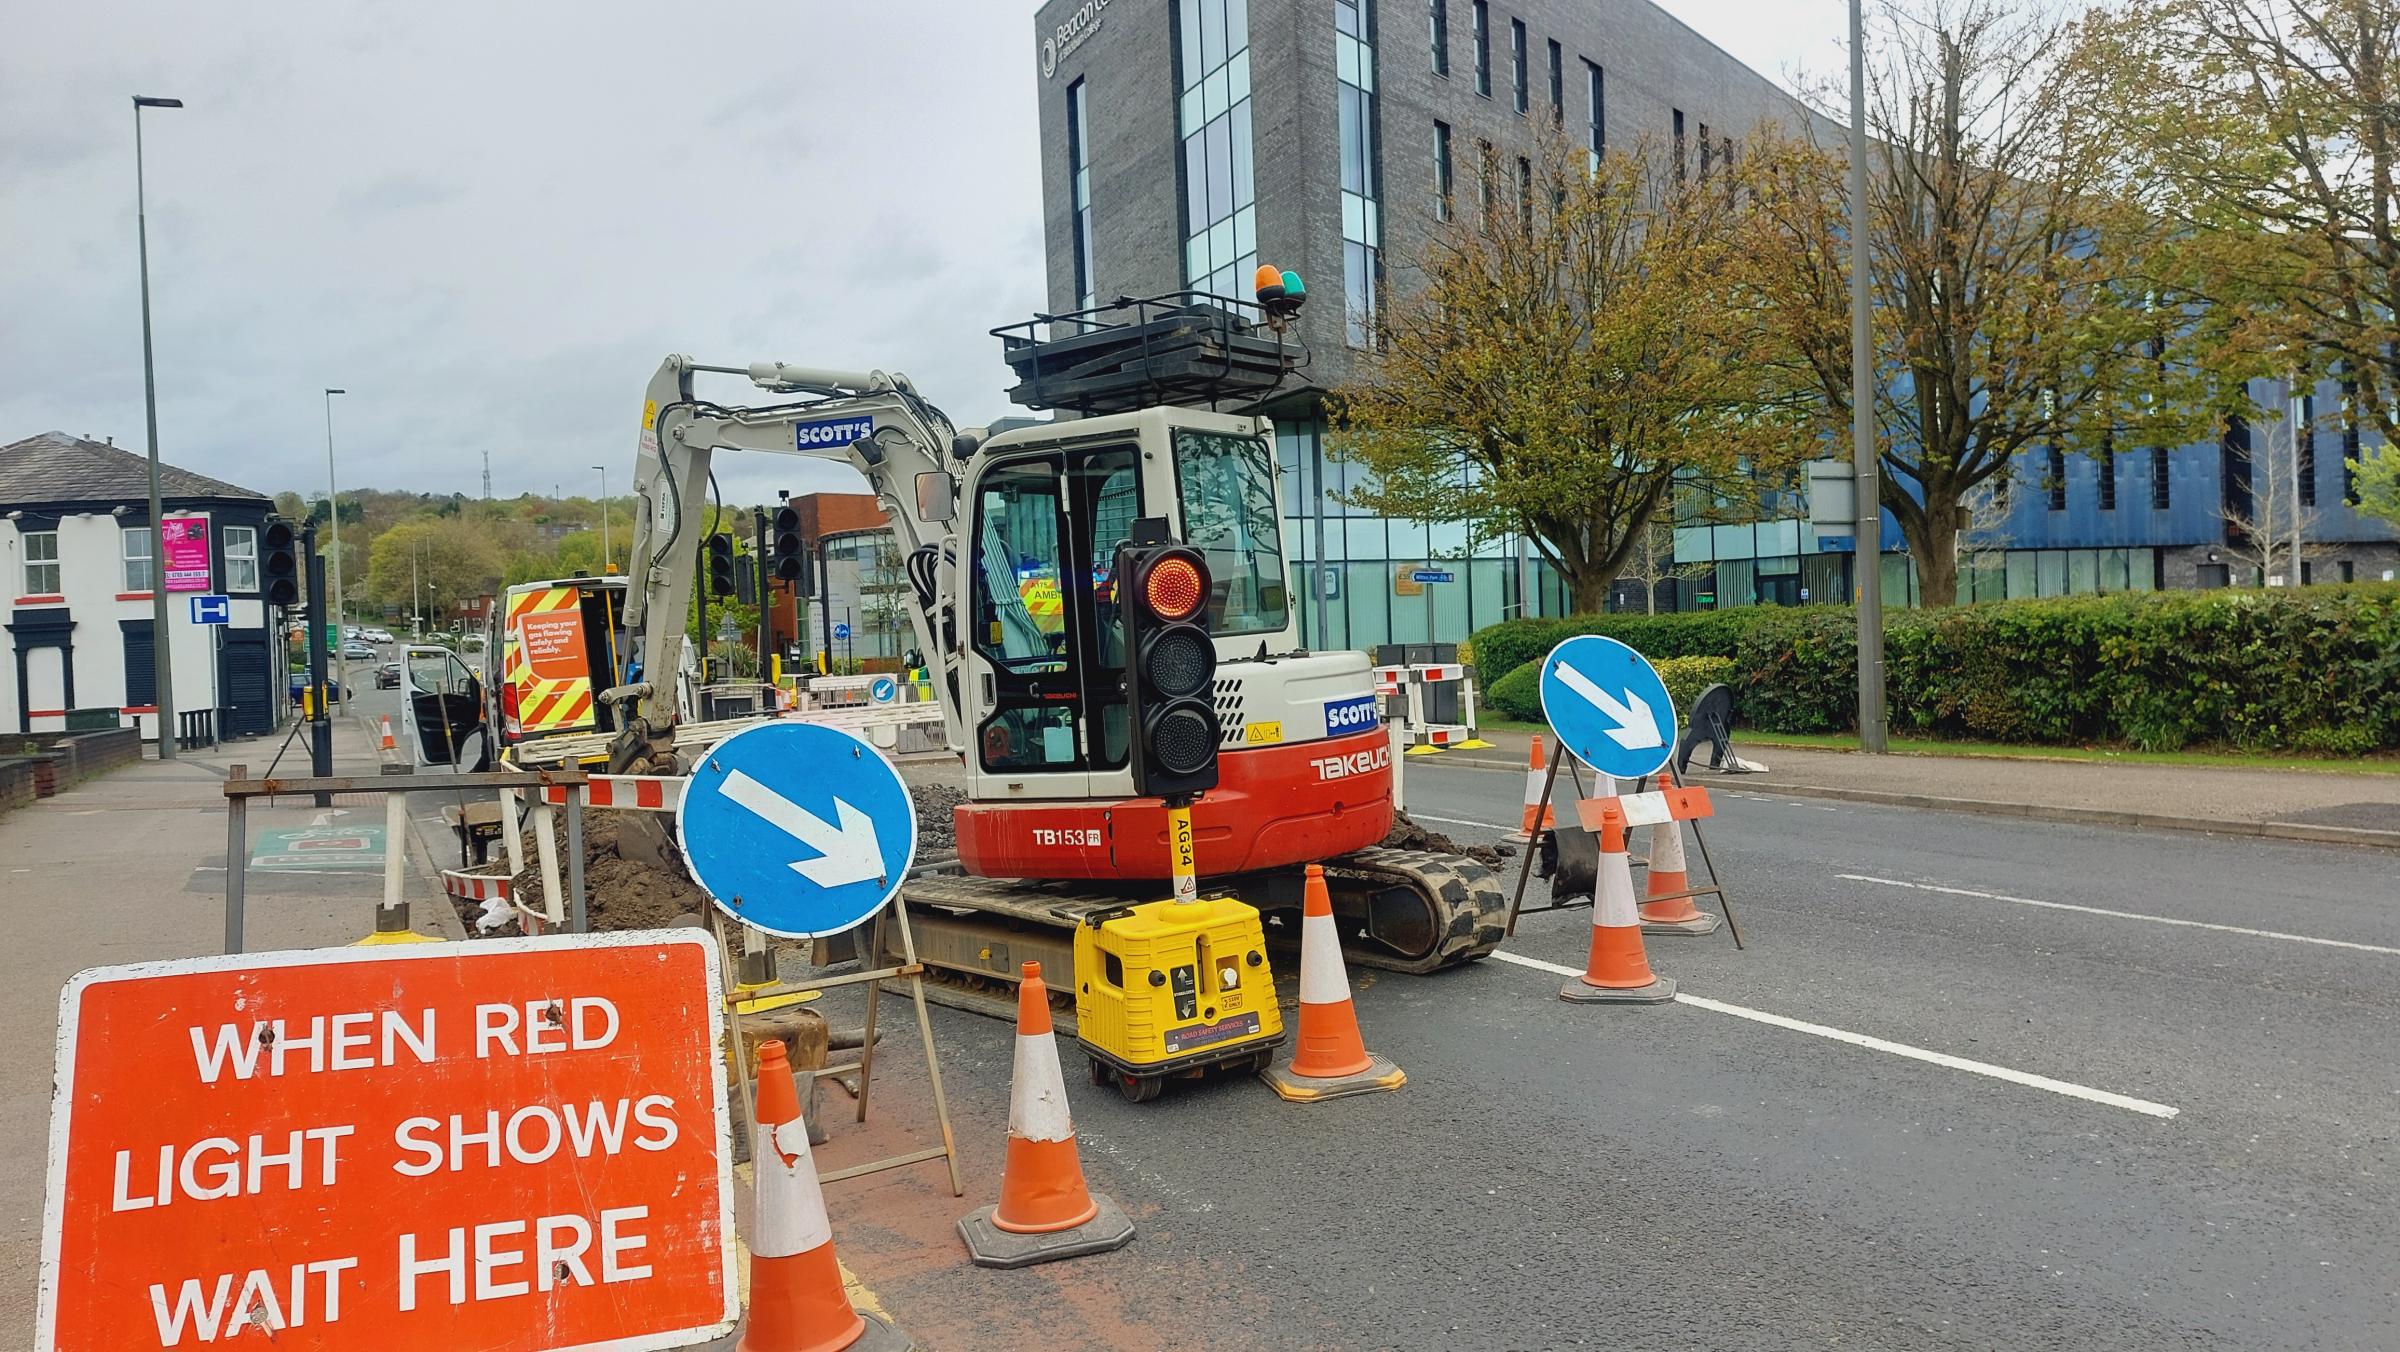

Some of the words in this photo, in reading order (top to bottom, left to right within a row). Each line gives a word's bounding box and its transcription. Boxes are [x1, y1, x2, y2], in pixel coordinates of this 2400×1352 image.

[1057, 2, 1093, 48] Beacon
[799, 422, 871, 444] SCOTT'S
[1034, 590, 1060, 599] AMB
[527, 621, 559, 631] Keeping
[560, 621, 577, 629] your
[528, 631, 542, 639] gas
[543, 629, 573, 637] flowing
[529, 638, 552, 647] safely
[553, 636, 568, 644] and
[530, 645, 561, 655] reliably.
[1032, 829, 1085, 846] TB153
[1088, 833, 1099, 843] FR
[1177, 819, 1192, 867] AG34
[190, 1009, 435, 1083] WHEN
[476, 997, 619, 1057] RED
[1181, 1031, 1197, 1040] ROAD
[1198, 1026, 1218, 1037] SAFETY
[1219, 1020, 1244, 1032] SERVICES
[113, 1125, 354, 1211] LIGHT
[393, 1095, 678, 1176] SHOWS
[150, 1257, 357, 1346] WAIT
[400, 1206, 652, 1311] HERE
